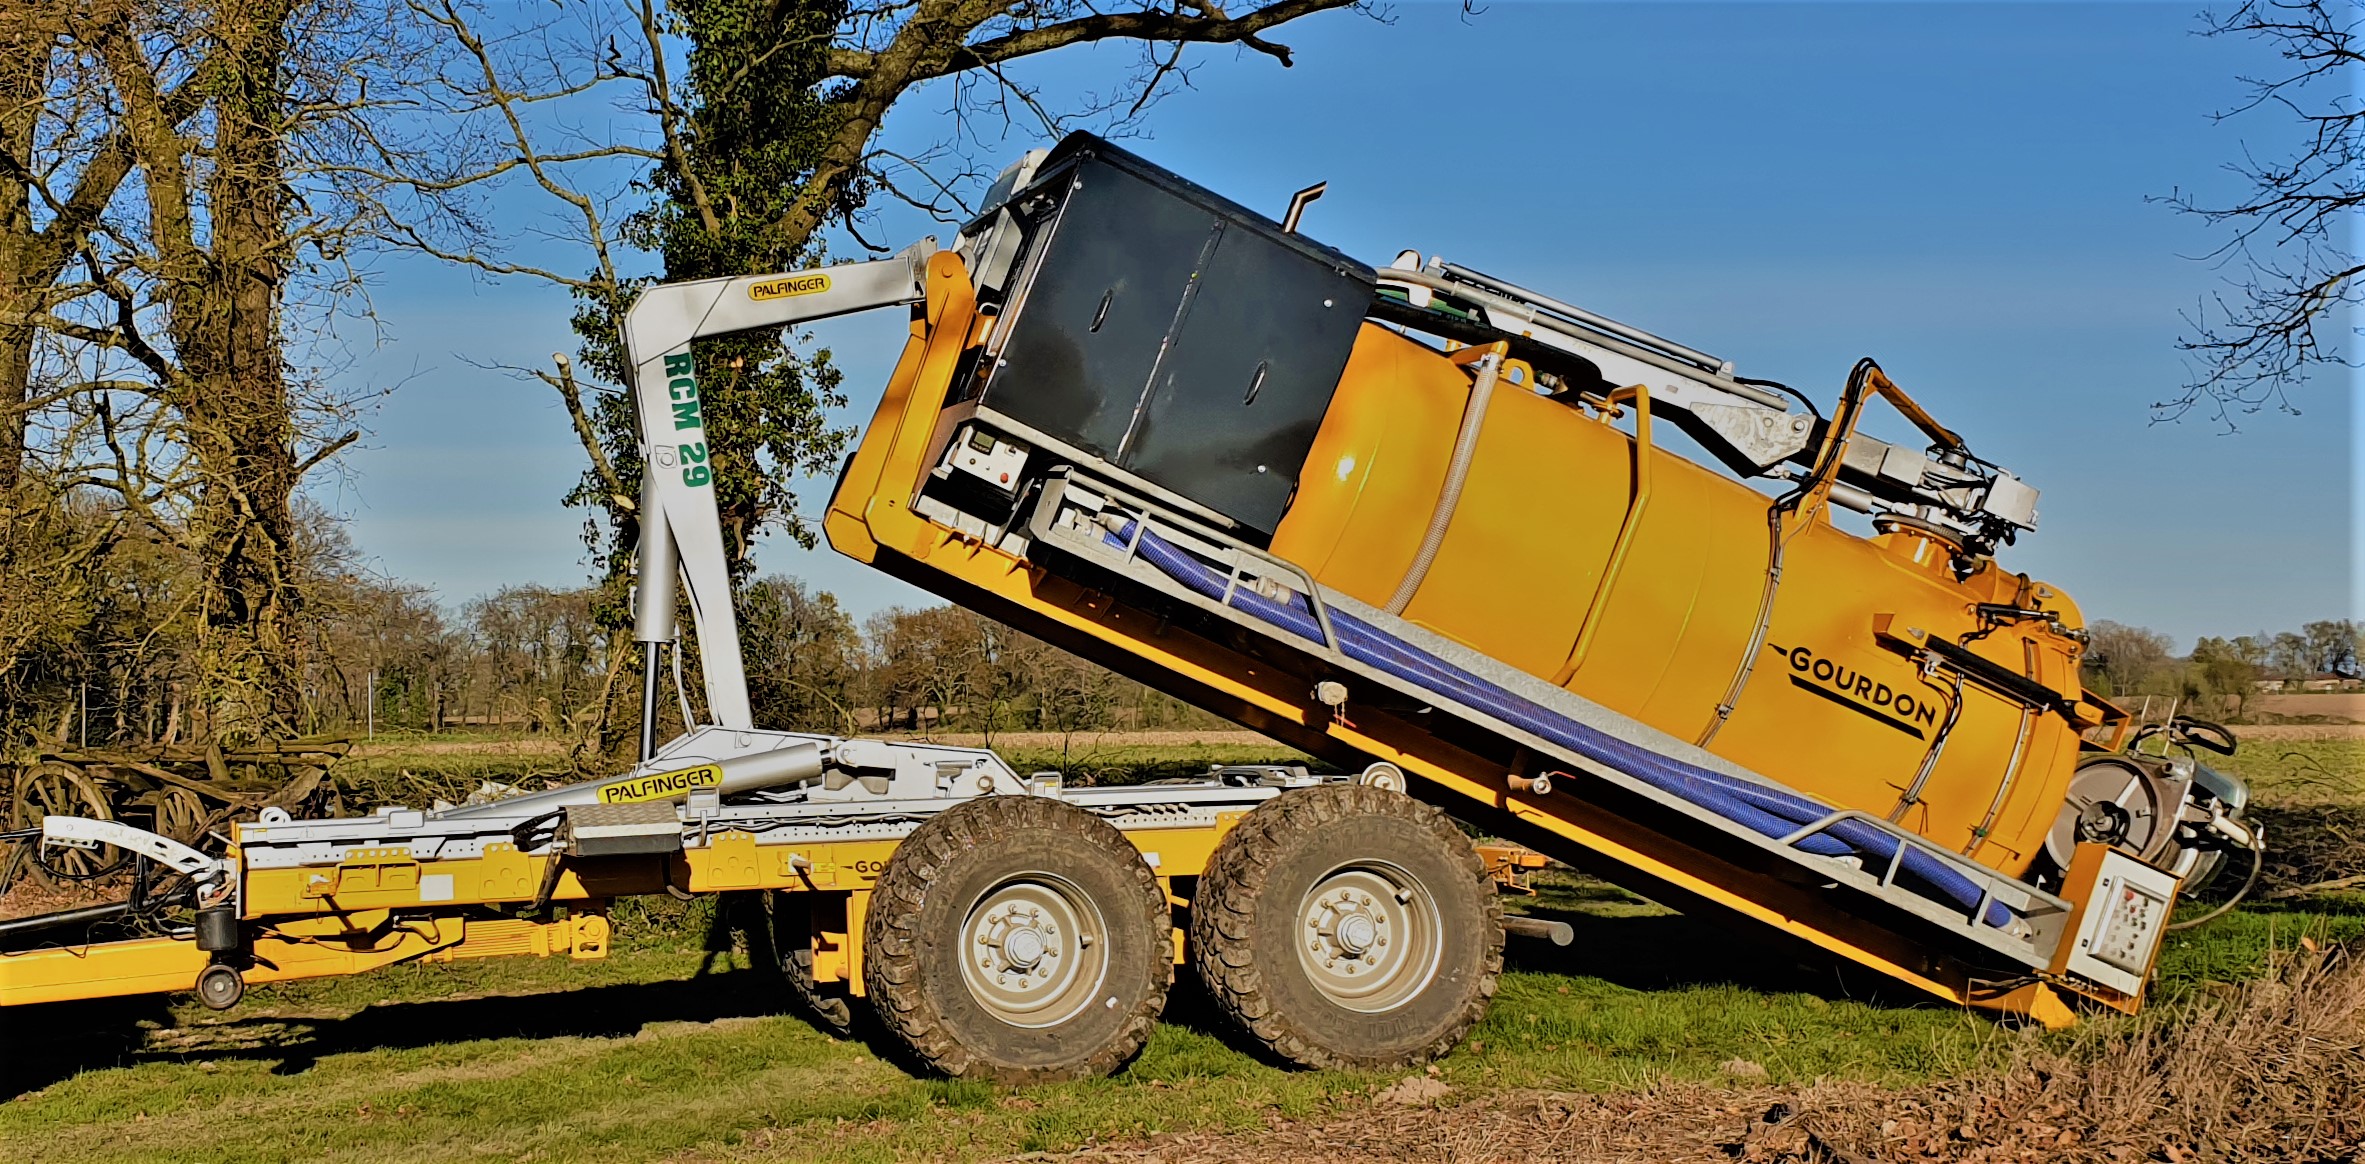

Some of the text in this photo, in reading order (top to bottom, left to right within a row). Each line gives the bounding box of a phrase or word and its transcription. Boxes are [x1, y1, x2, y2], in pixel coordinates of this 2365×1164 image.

[753, 277, 825, 297] PALFINGER
[664, 352, 710, 487] RCM 29
[1790, 646, 1936, 727] GOURDON
[605, 768, 714, 803] PALFINGER
[855, 860, 887, 873] GO
